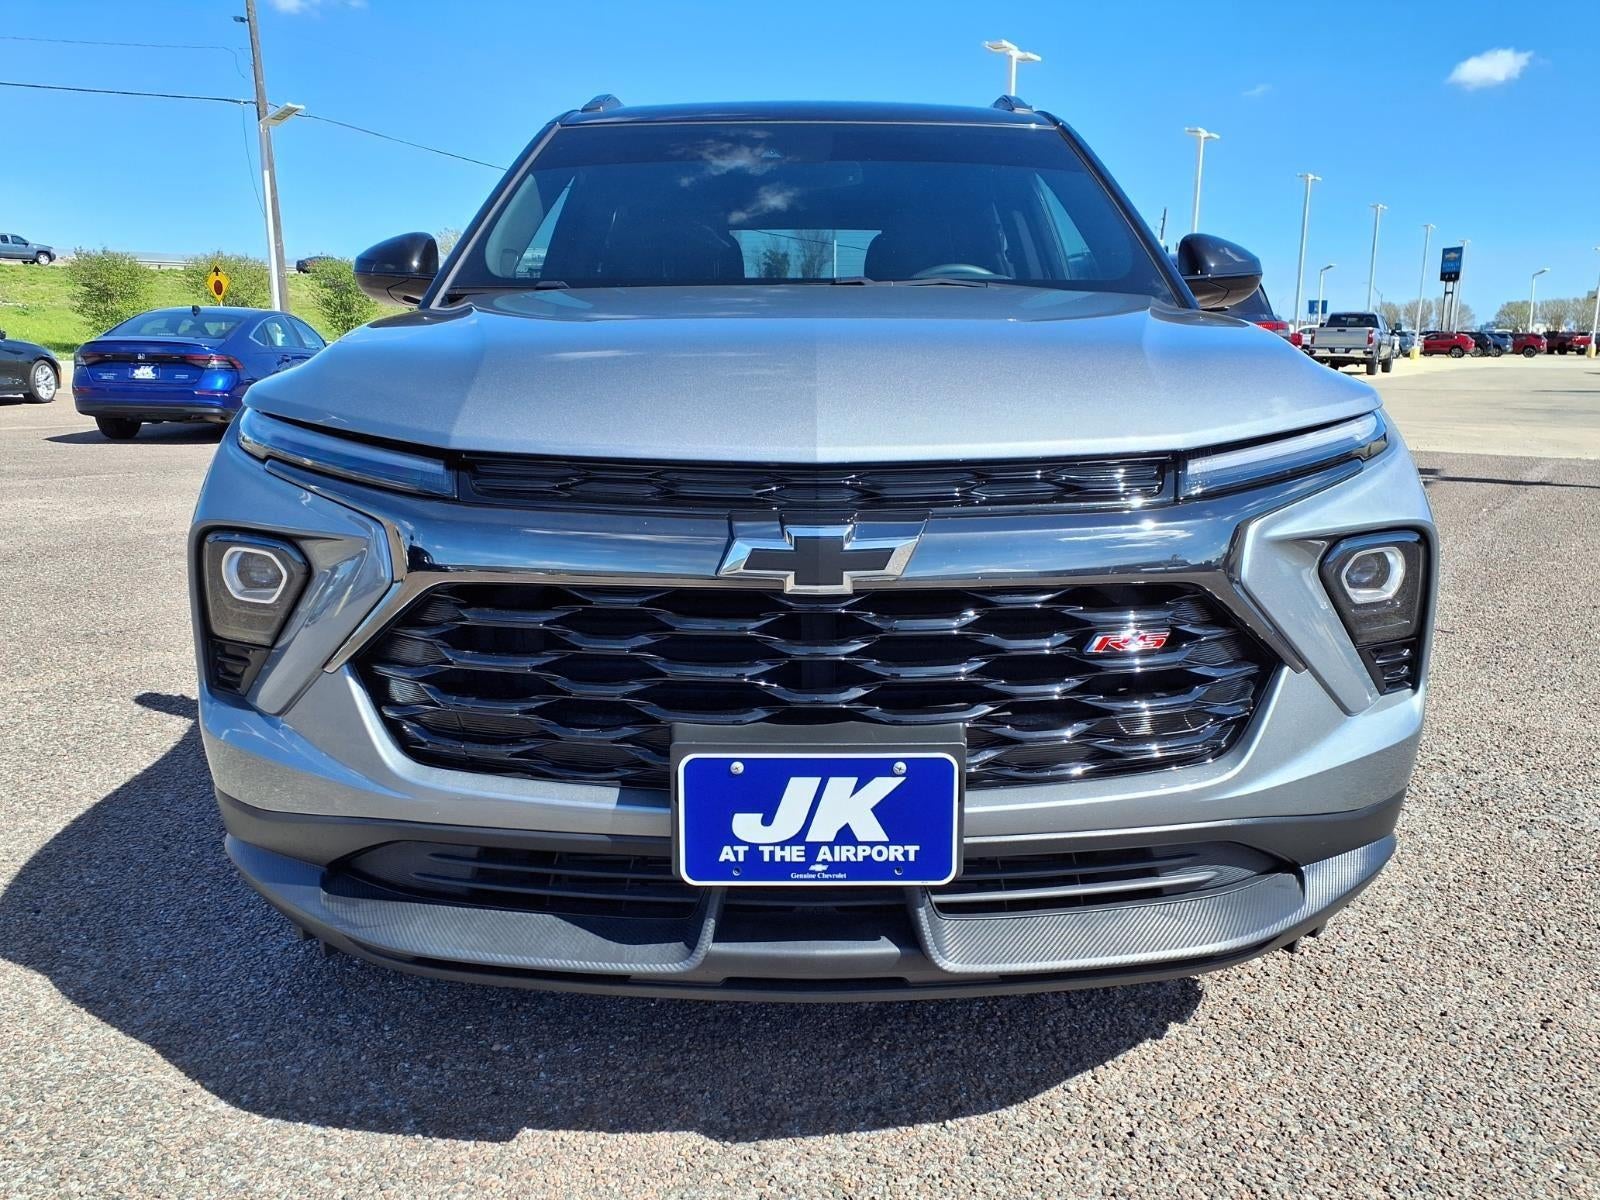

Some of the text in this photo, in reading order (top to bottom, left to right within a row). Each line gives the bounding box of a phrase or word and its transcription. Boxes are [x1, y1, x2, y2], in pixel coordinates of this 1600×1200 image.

[1086, 631, 1170, 653] RS
[731, 776, 907, 844] JK
[718, 845, 920, 862] AT THE AIRPORT
